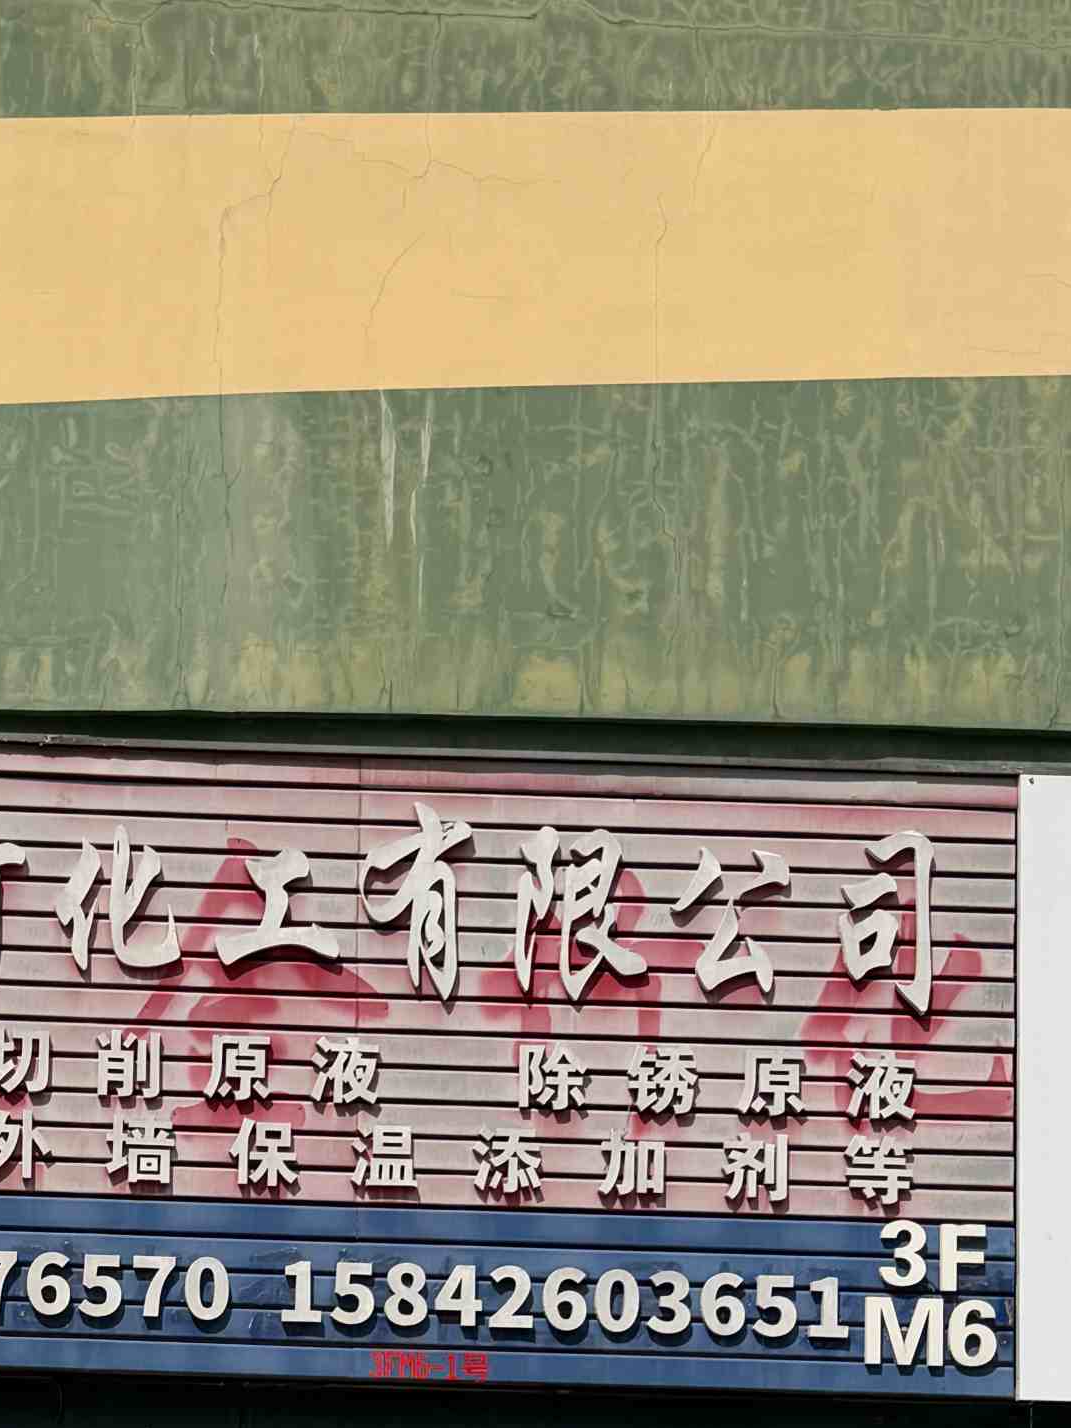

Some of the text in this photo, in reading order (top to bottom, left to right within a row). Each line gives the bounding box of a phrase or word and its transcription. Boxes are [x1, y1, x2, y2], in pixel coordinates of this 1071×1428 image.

[519, 1044, 916, 1120] 除锈原液
[880, 1219, 988, 1293] 3F
[280, 1259, 850, 1341] 15842603651
[863, 1296, 997, 1369] M6
